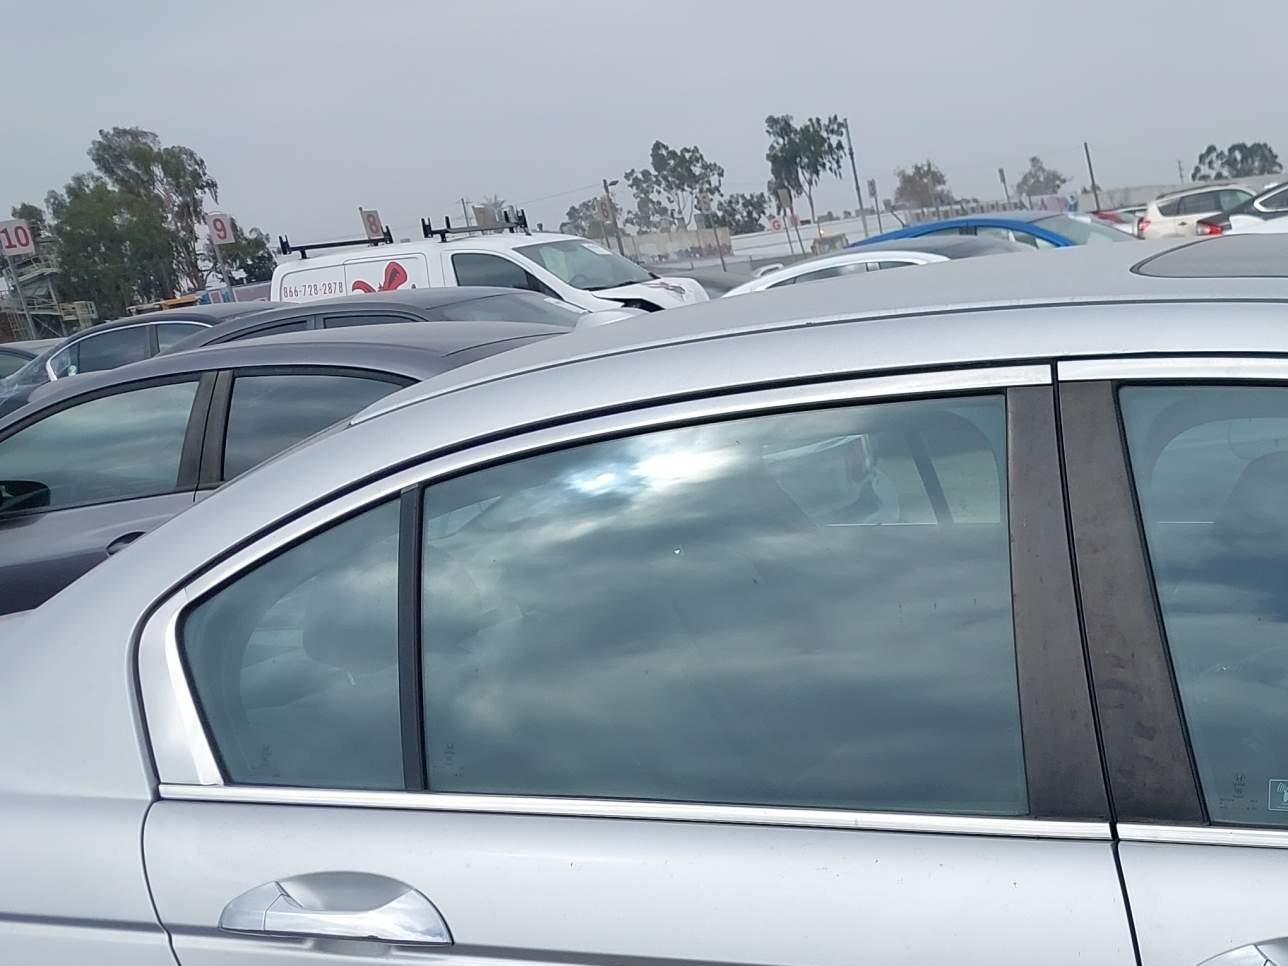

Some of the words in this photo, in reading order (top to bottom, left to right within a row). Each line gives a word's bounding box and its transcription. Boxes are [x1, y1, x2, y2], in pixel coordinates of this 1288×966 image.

[212, 217, 227, 241] 9
[366, 213, 380, 234] 8
[0, 225, 30, 249] 10
